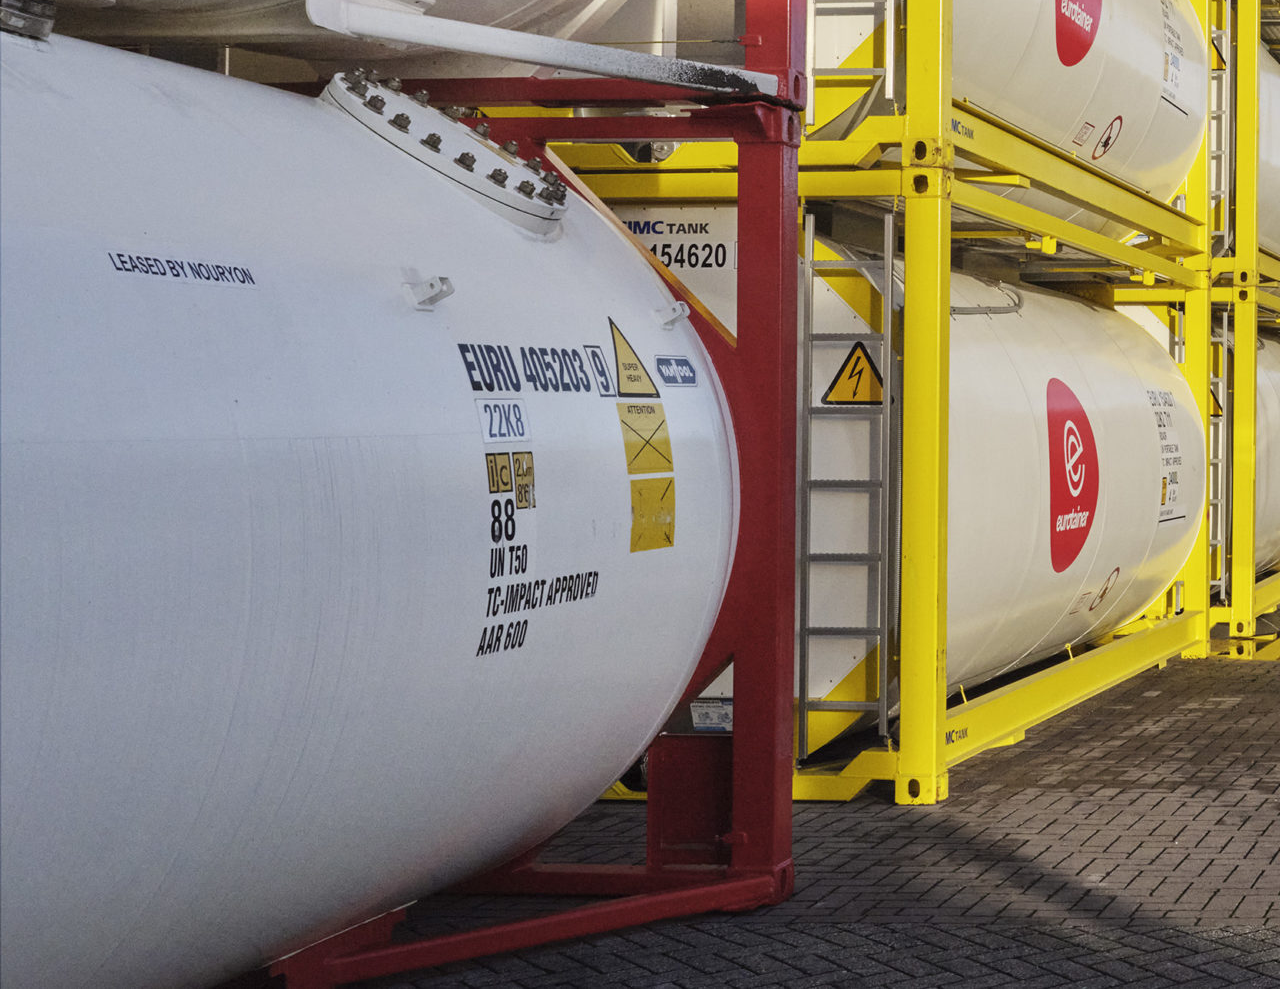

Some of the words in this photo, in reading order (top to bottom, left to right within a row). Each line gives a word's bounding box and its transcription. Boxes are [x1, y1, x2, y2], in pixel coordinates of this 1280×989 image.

[623, 221, 664, 234] IMC
[667, 223, 709, 234] TANK
[108, 252, 166, 277] LEASED
[166, 259, 188, 278] BY
[188, 261, 256, 286] NOURYON
[650, 243, 727, 268] 154620
[457, 343, 521, 392] EURU
[520, 346, 591, 392] 405203
[591, 349, 611, 393] 9
[484, 403, 525, 438] 22K8
[627, 405, 656, 415] ATTENTION
[491, 499, 516, 543] 88
[1056, 505, 1089, 532] eurotainer
[490, 547, 504, 578] UN
[509, 544, 528, 575] T50
[486, 580, 547, 618] TC-IMPACT
[546, 571, 598, 606] APPROVED
[476, 624, 504, 657] AAR
[503, 619, 528, 651] 600
